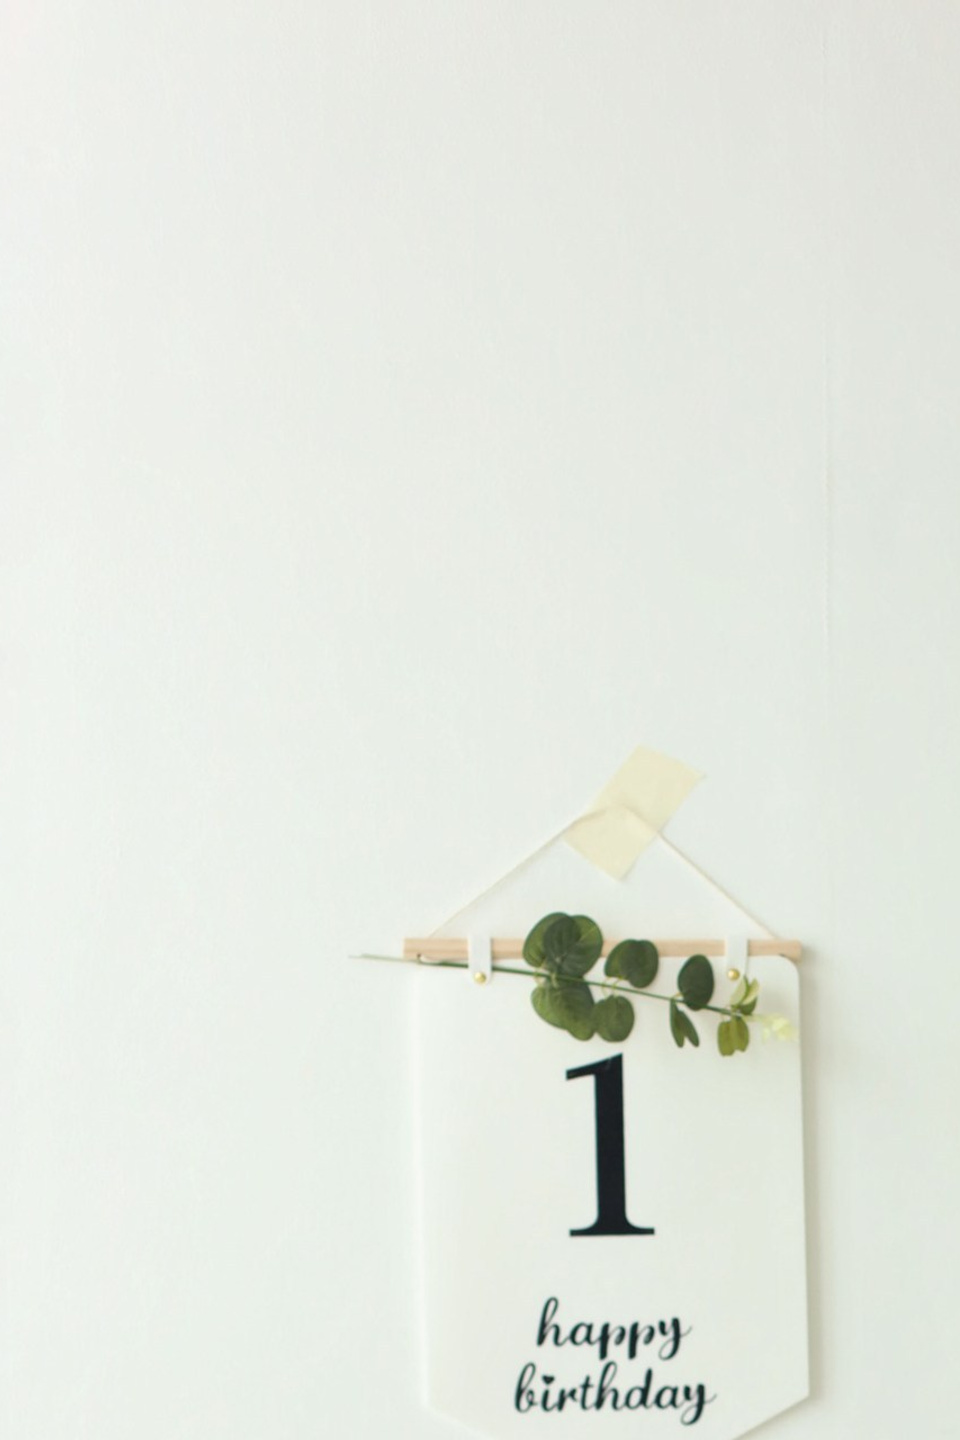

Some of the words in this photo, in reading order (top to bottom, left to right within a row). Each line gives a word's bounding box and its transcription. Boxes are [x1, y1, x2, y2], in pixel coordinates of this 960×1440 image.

[565, 1053, 655, 1237] 1
[536, 1297, 690, 1360] happy
[514, 1360, 716, 1426] birthday
